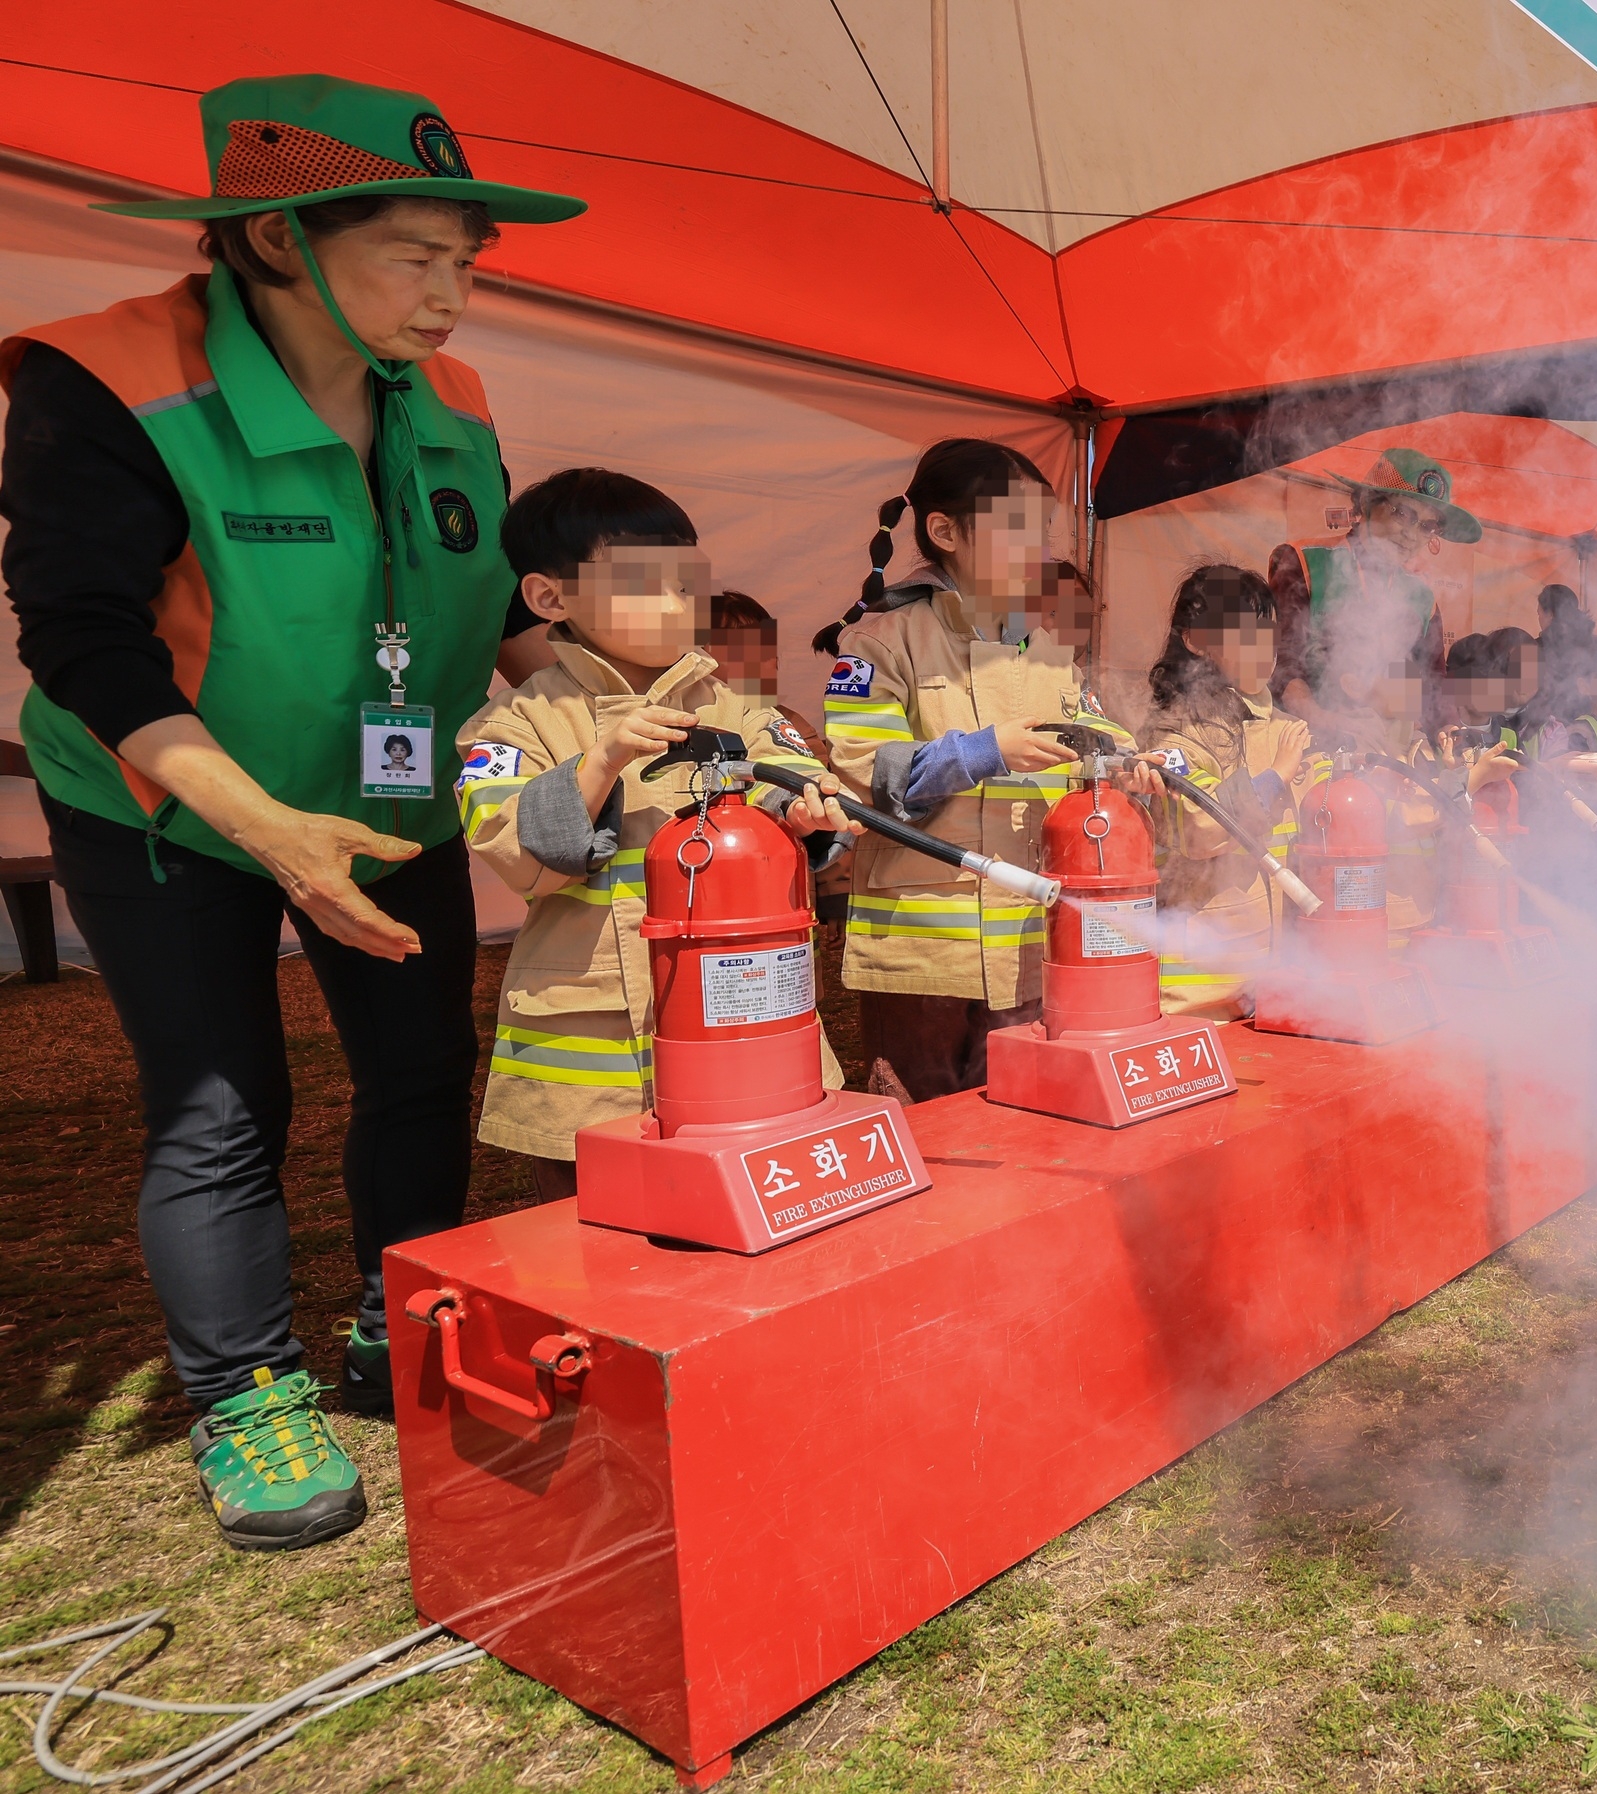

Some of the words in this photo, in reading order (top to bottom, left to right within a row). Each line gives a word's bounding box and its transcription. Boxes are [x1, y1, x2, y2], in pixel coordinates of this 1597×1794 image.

[723, 958, 750, 967] 주의사항
[1123, 1037, 1213, 1087] 소화기
[1130, 1093, 1155, 1109] FIRE
[1154, 1073, 1221, 1102] EXTINGUISHER
[763, 1123, 895, 1198] 소화기
[772, 1204, 808, 1227] FIRE
[808, 1169, 907, 1214] EXTINGUISHER
